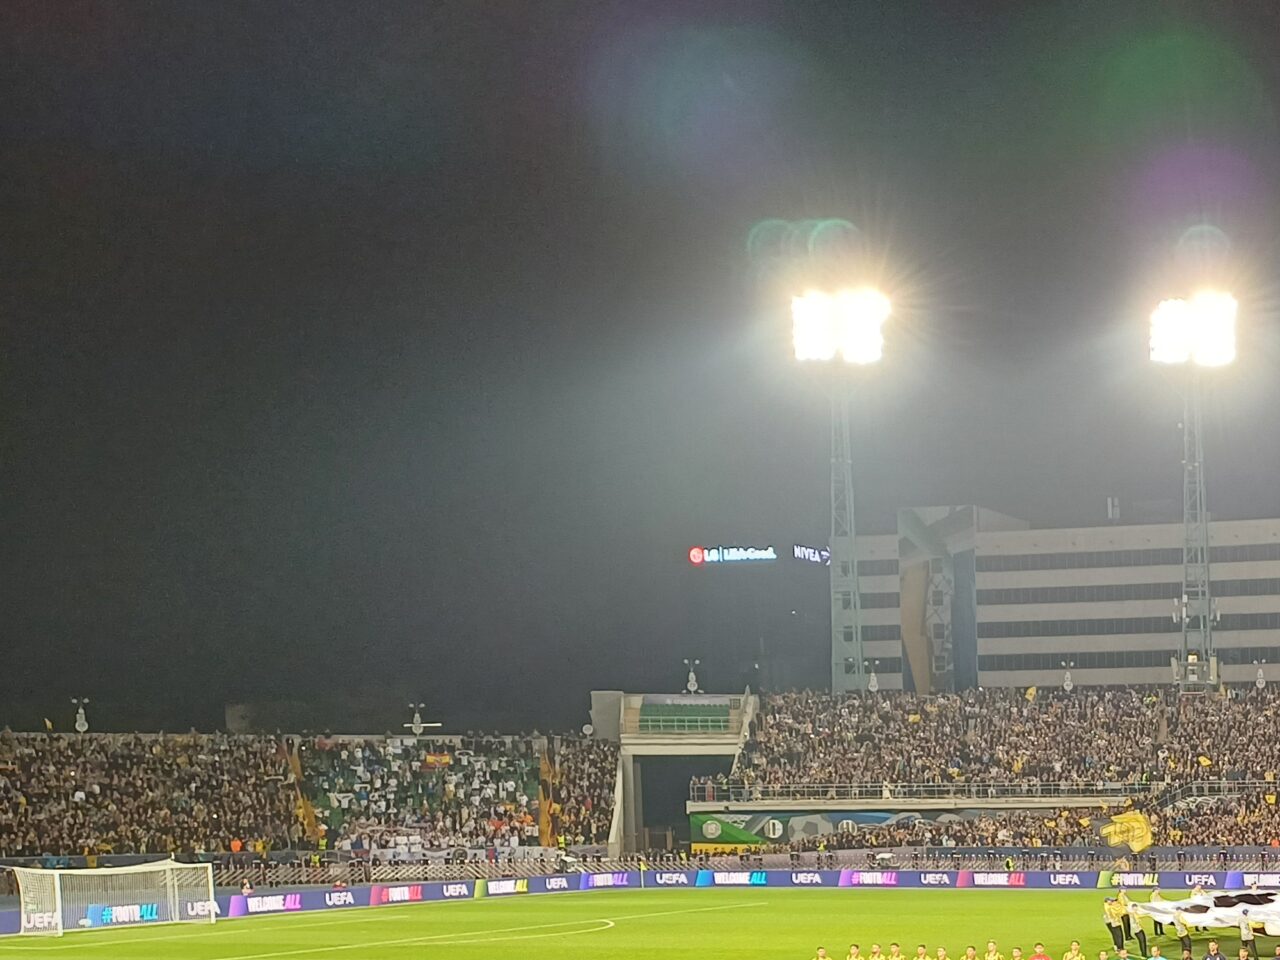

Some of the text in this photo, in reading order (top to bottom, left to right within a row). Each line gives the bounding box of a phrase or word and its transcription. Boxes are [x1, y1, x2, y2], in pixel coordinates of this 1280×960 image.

[793, 544, 821, 563] NIVEA
[545, 876, 568, 890] UEFA
[655, 872, 688, 885] UEFA
[792, 872, 821, 885] UEFA
[920, 872, 950, 885] UEFA
[1050, 873, 1080, 886] UEFA
[1185, 873, 1216, 887] UEFA
[442, 884, 469, 897] UEFA
[325, 891, 354, 906] UEFA
